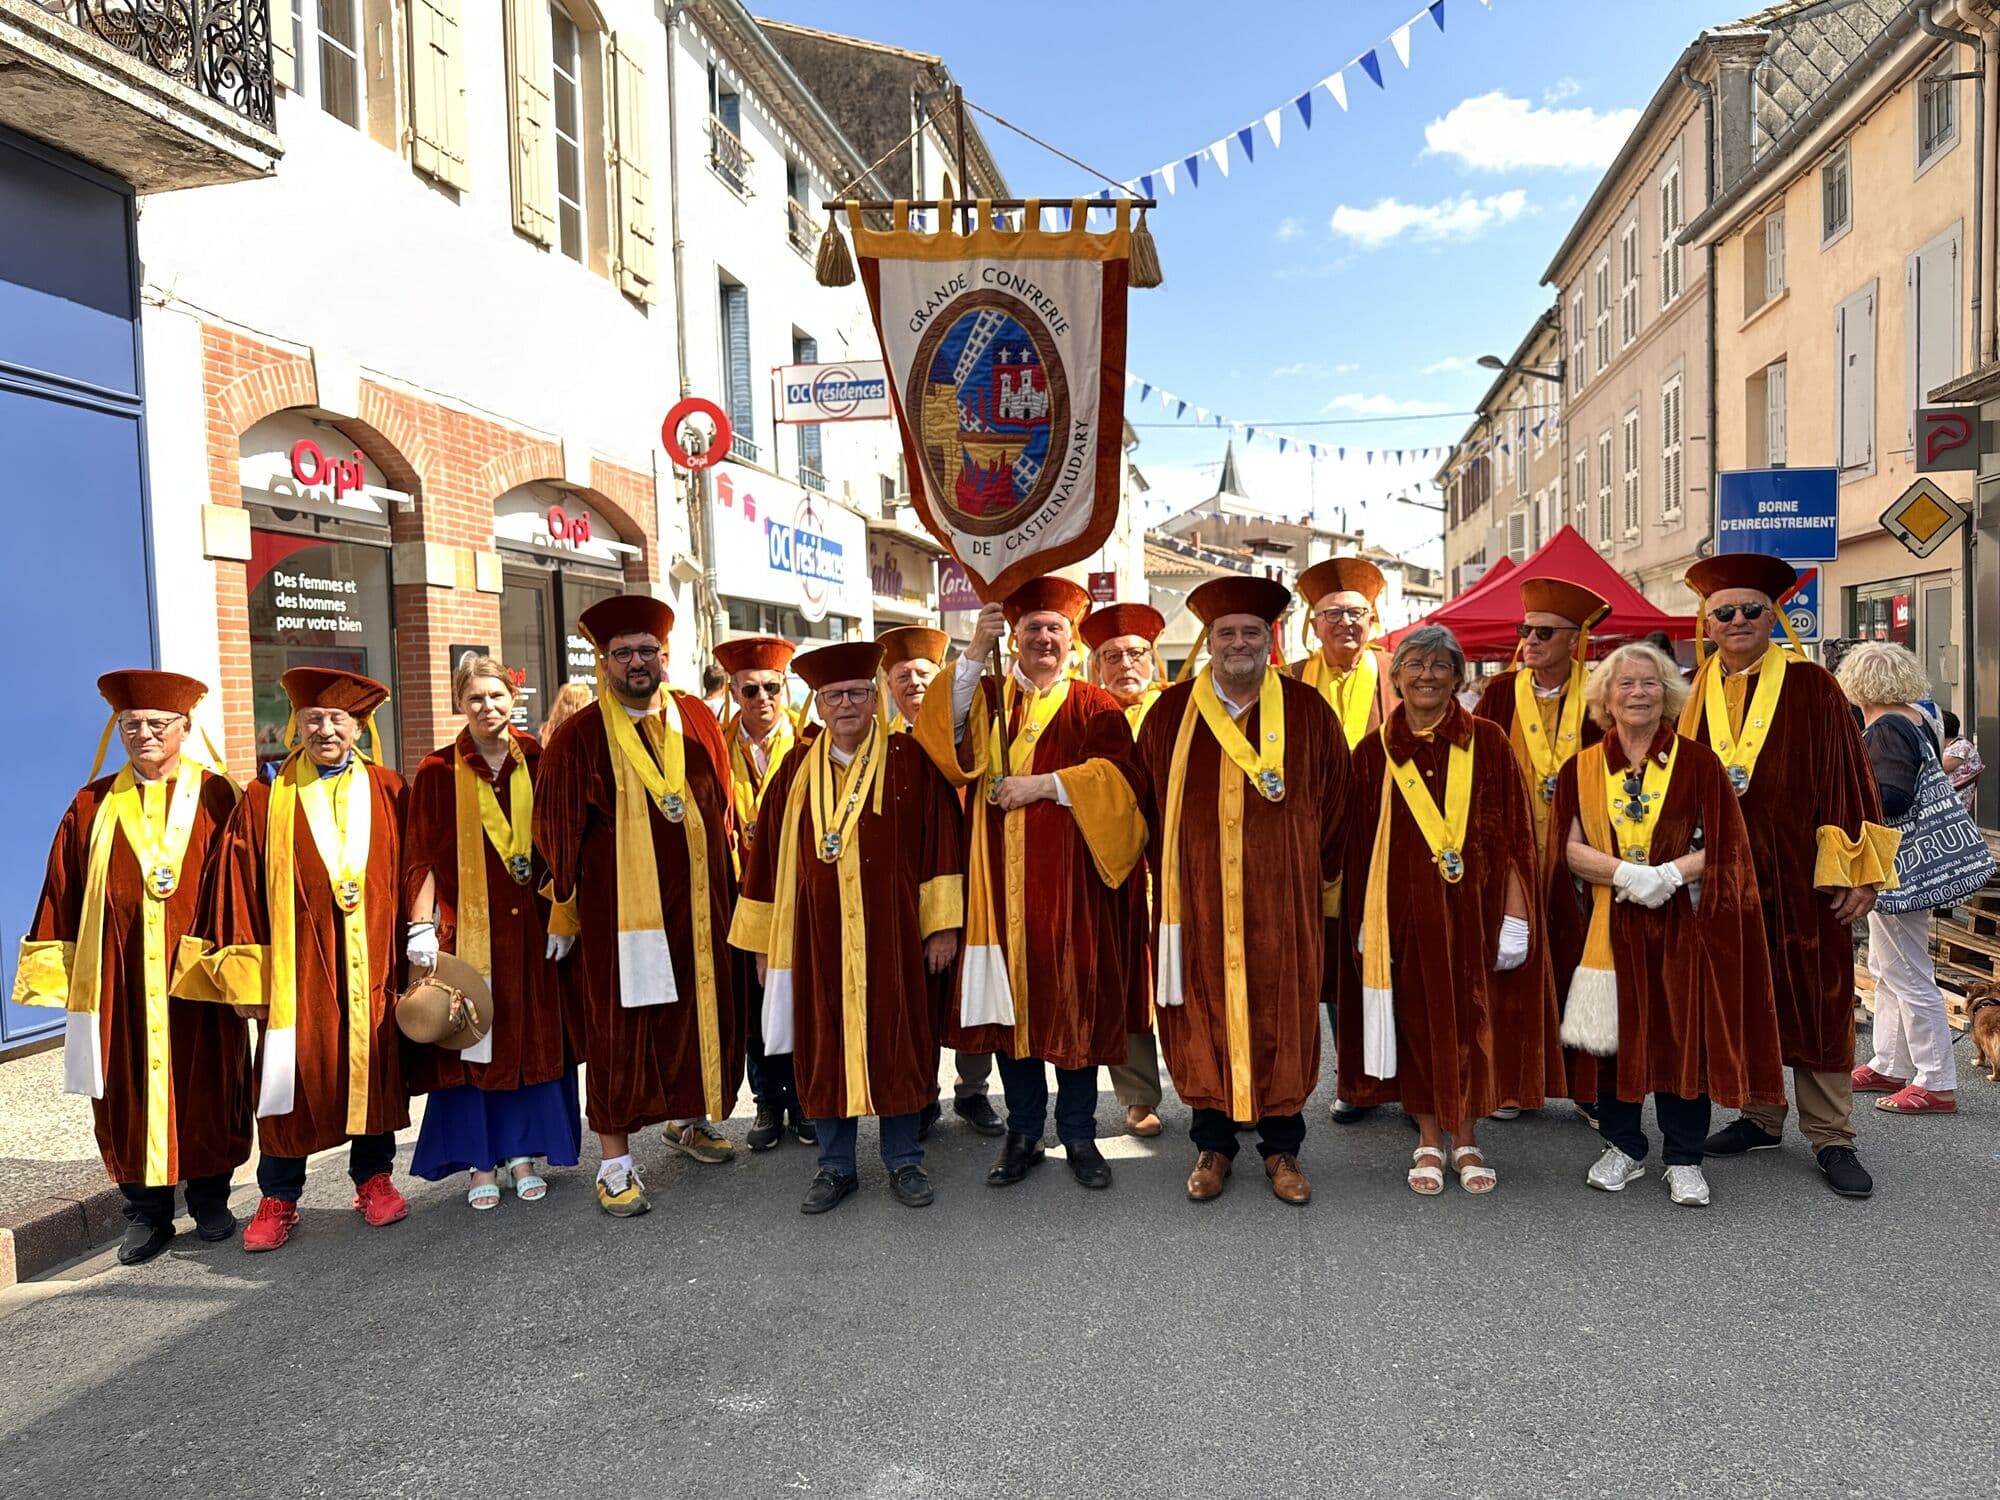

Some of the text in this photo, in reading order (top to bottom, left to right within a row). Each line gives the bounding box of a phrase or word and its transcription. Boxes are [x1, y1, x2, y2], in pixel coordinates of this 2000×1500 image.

[909, 267, 1069, 336] GRANDE CONFRERIE
[790, 381, 884, 402] OC résidences
[291, 438, 365, 499] Orpi
[686, 454, 708, 468] Orpi
[972, 420, 1089, 556] DE CASTELNAUDARY
[1758, 500, 1799, 513] BORNE
[547, 504, 592, 549] Orpi
[1721, 516, 1836, 532] D'ENREGISTREMENT
[770, 524, 791, 569] OC
[274, 571, 357, 593] Des femmes et
[275, 592, 347, 612] des hommes
[276, 616, 363, 632] pour votre bien
[1792, 617, 1809, 628] 20
